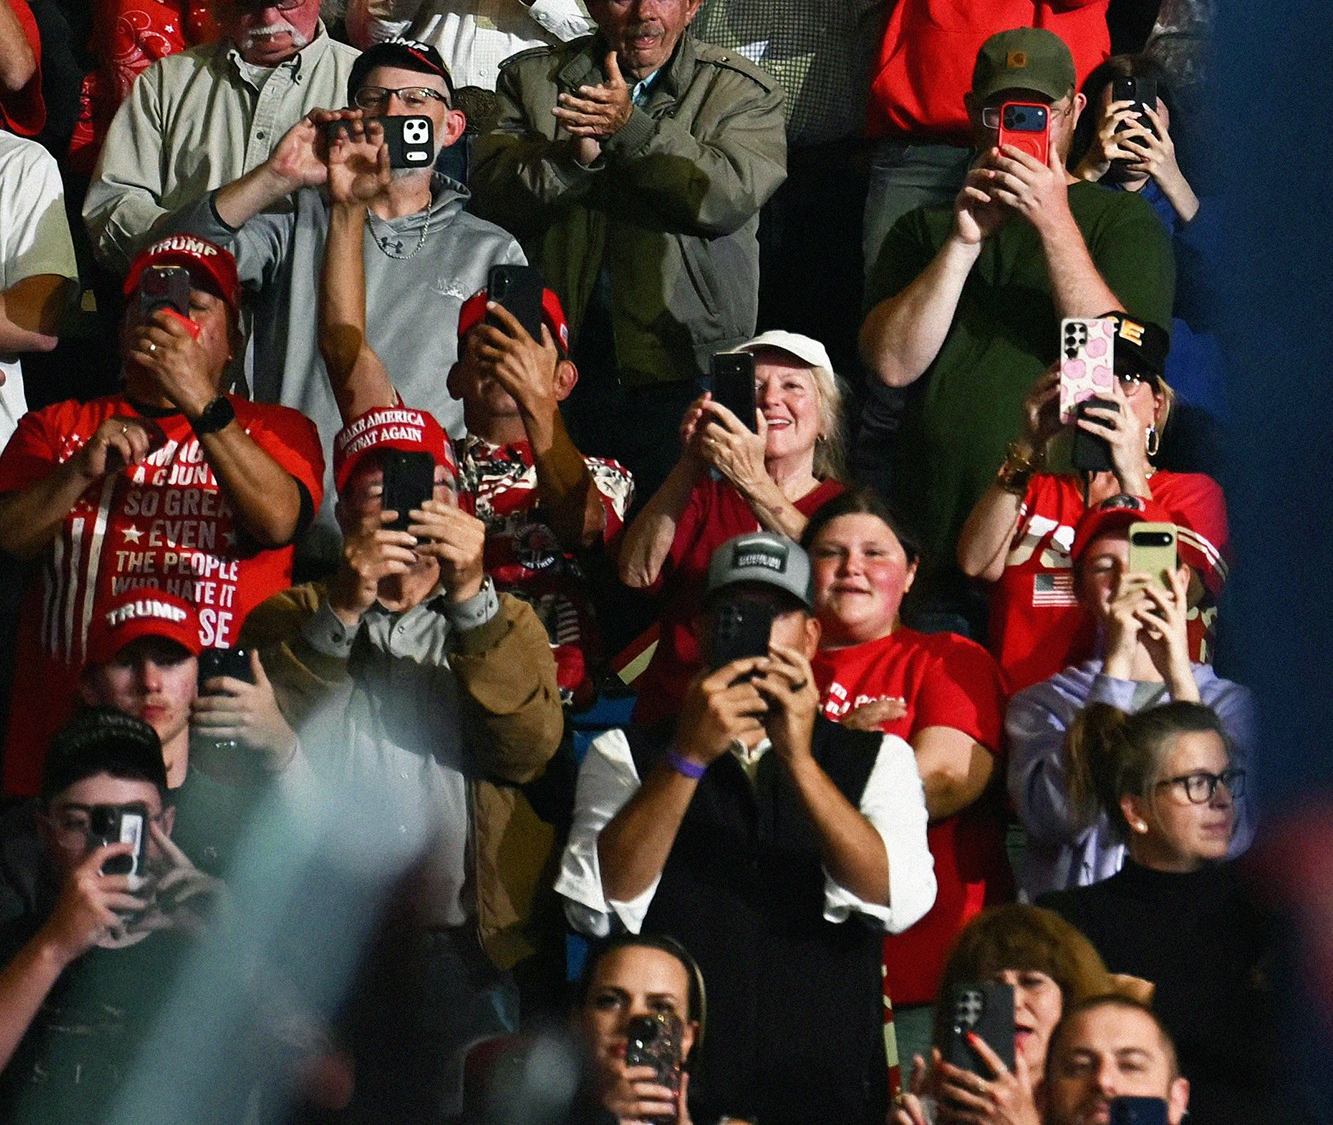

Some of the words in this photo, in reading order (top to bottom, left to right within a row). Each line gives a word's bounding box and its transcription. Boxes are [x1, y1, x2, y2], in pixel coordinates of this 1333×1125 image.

[149, 236, 218, 257] TRUMP
[367, 410, 425, 429] AMERICA
[379, 427, 422, 443] AGAIN
[132, 465, 145, 483] A
[124, 490, 157, 517] SO
[164, 488, 233, 517] GREA
[149, 519, 216, 550] EVEN
[116, 550, 156, 575] THE
[164, 551, 238, 582] PEOPLE
[167, 577, 216, 605] HATE
[219, 584, 237, 608] IT
[106, 600, 187, 626] TRUMP
